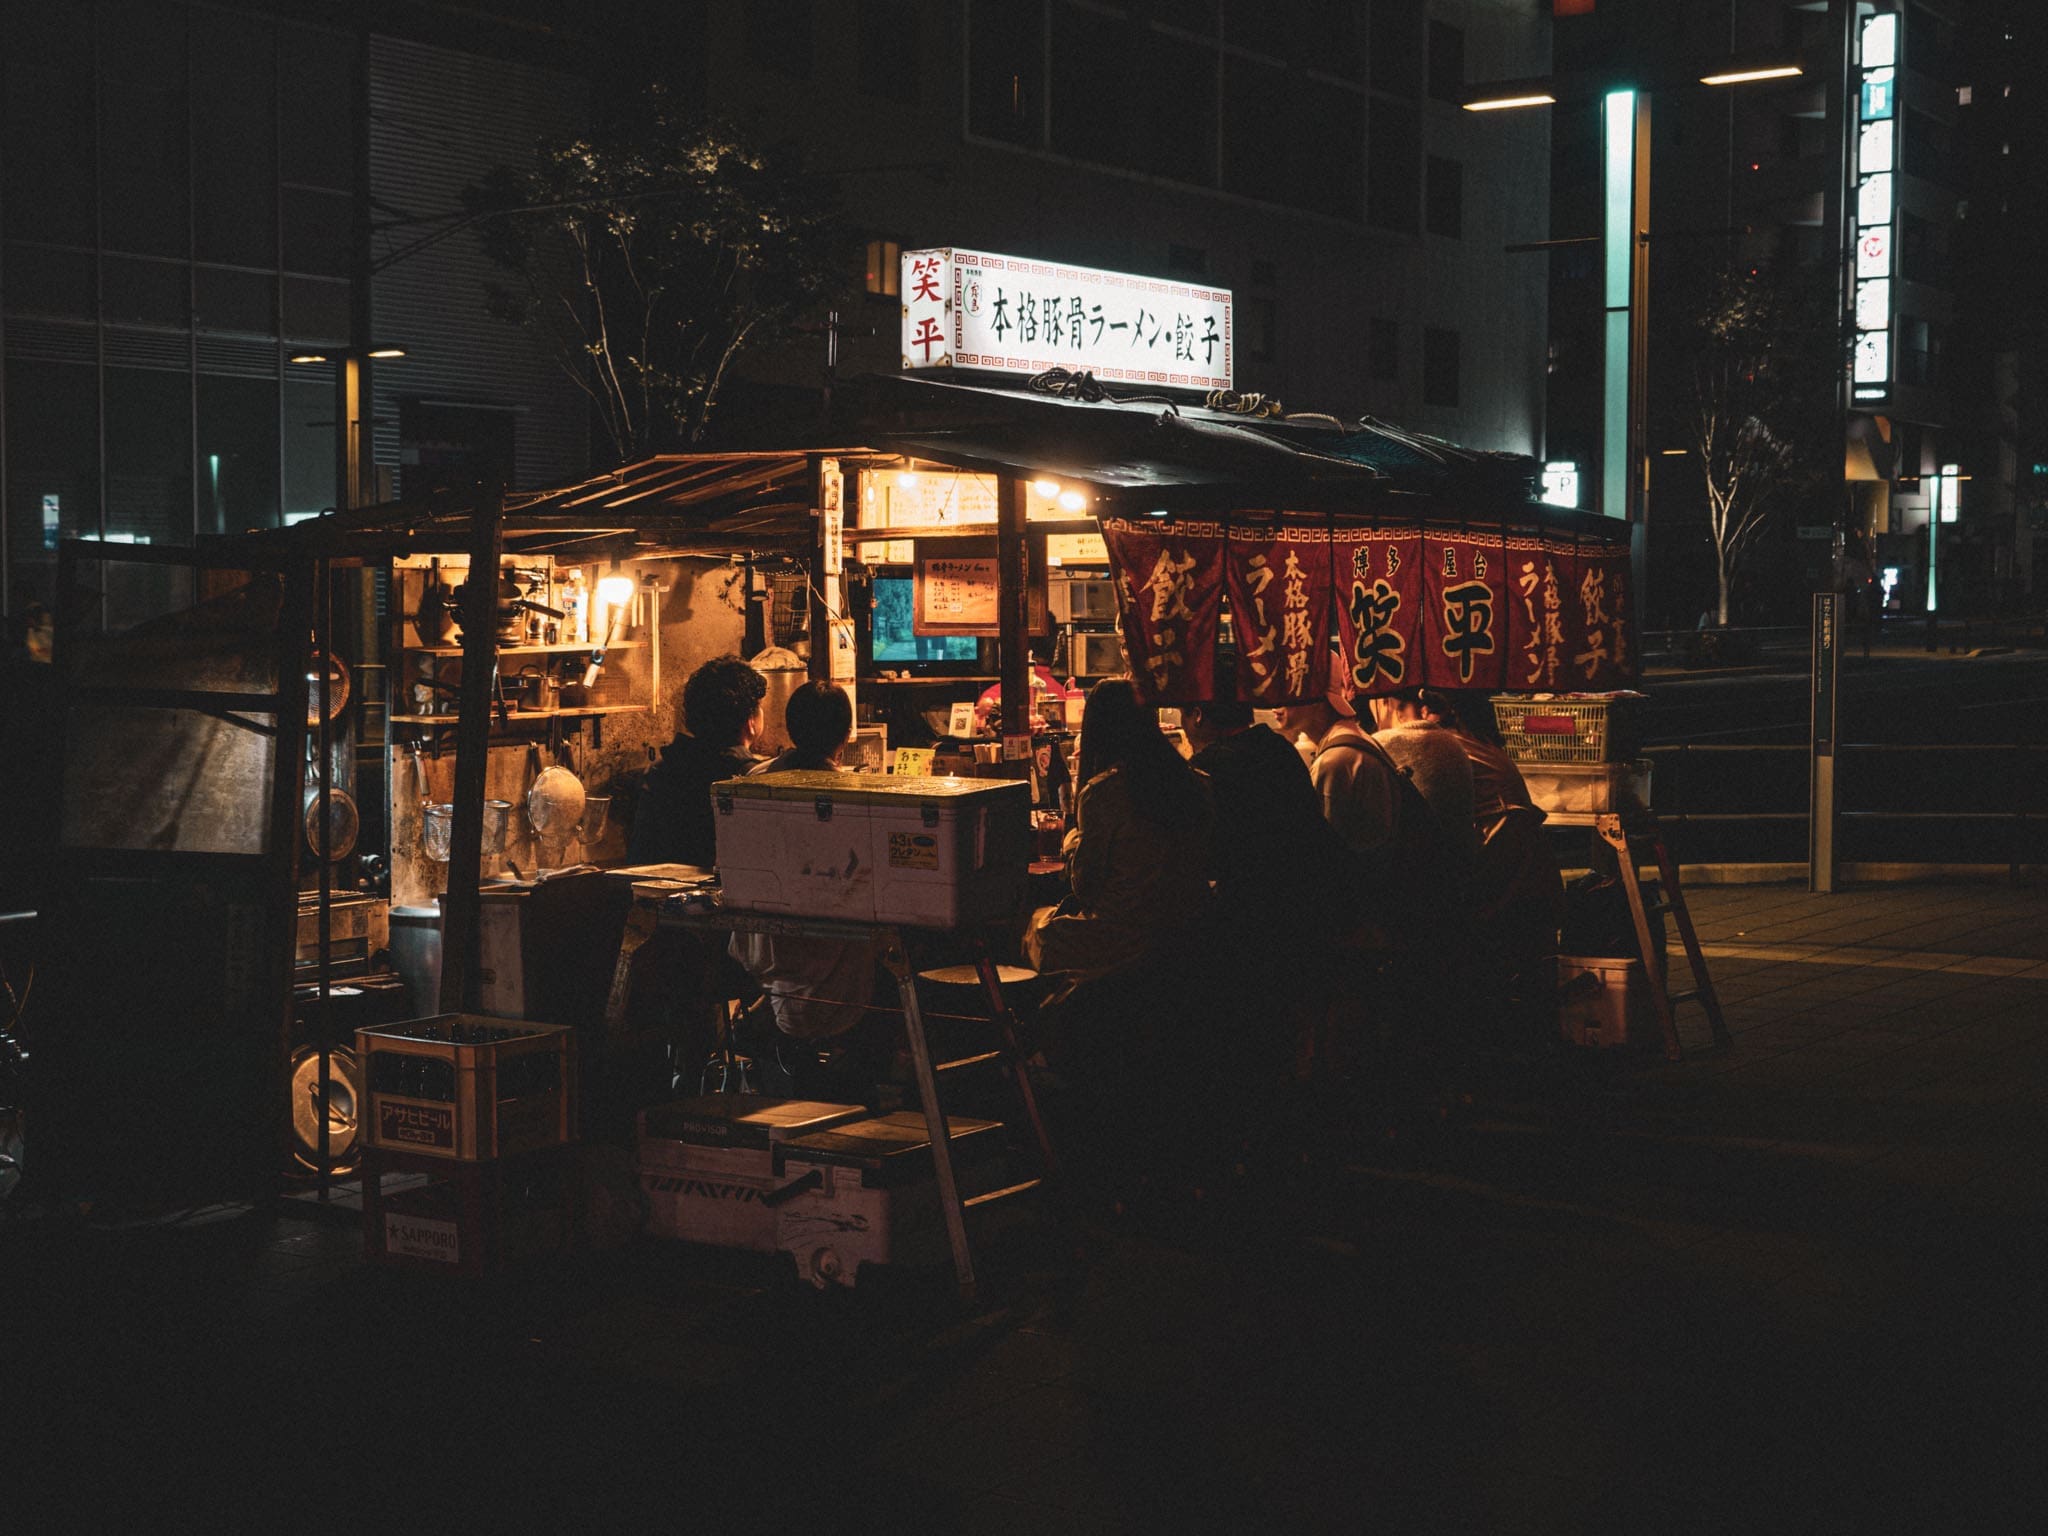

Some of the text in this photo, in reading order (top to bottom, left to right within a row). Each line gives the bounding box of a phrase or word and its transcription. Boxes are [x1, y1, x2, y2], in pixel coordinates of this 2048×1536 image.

[911, 256, 944, 363] 笑平
[1352, 545, 1488, 579] 博多 屋台
[1246, 553, 1279, 696] ラーメン
[1282, 549, 1314, 696] 本格豚骨
[1519, 561, 1544, 684] ラーメン
[1574, 567, 1610, 681] 餃子
[381, 1104, 450, 1130] アサヒビール
[683, 1121, 728, 1138] PROVISOR
[401, 1223, 456, 1249] SAPPORO
